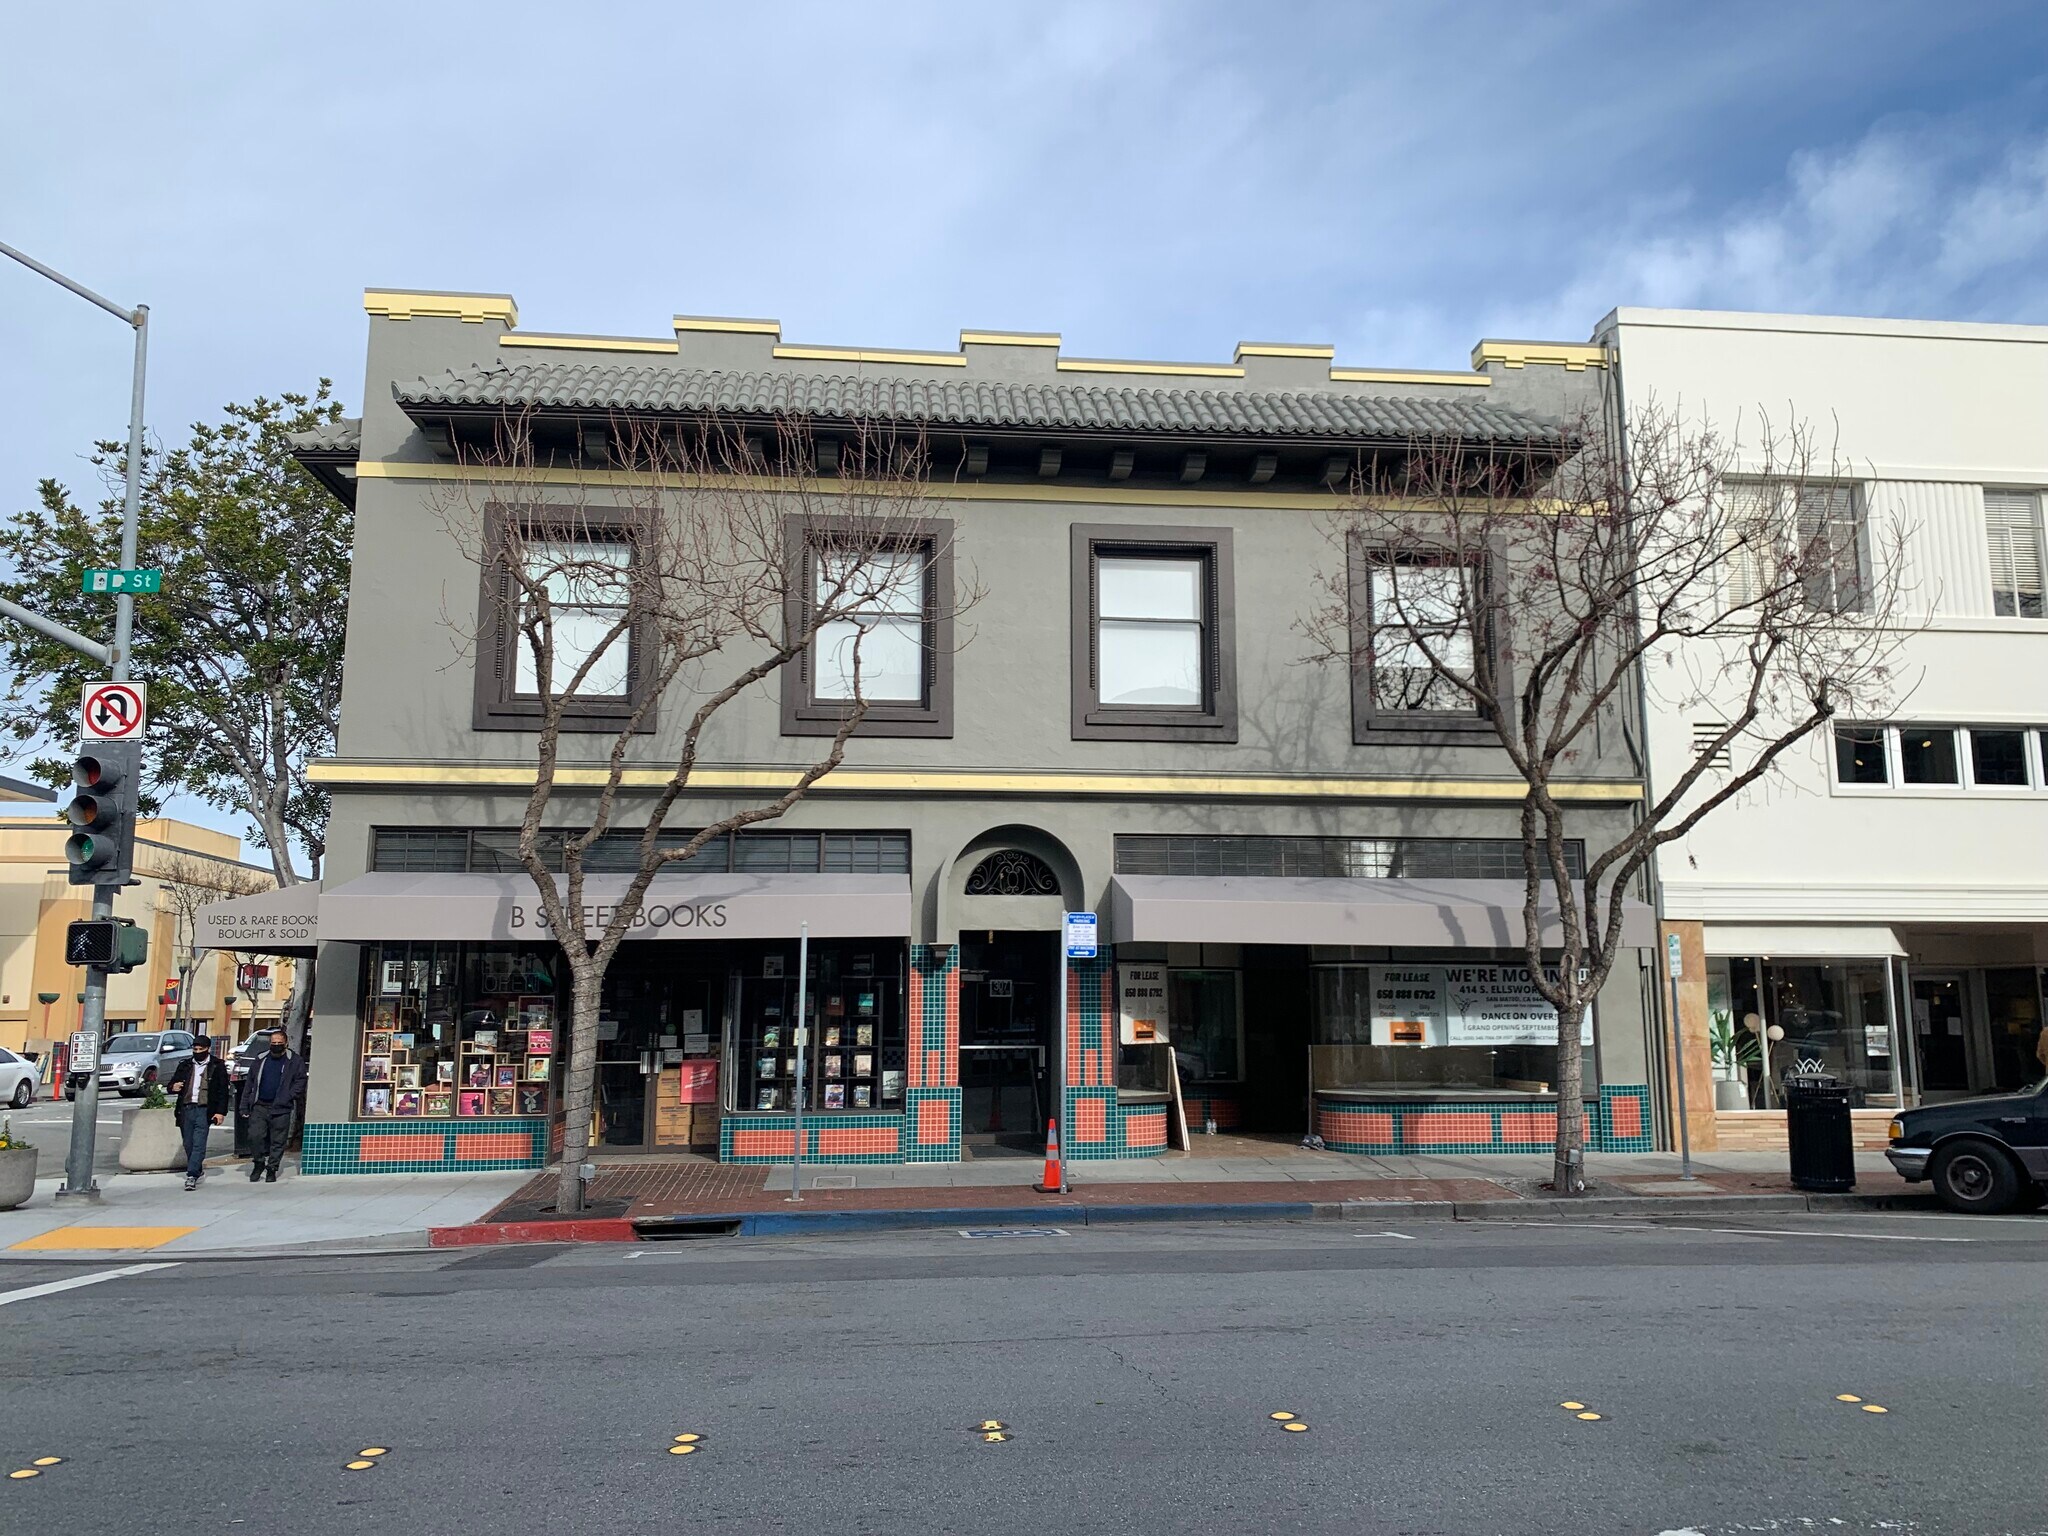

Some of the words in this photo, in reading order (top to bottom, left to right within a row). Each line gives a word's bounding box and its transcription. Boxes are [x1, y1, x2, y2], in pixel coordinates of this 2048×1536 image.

[133, 574, 151, 588] St
[208, 915, 236, 925] USED
[240, 915, 248, 925] &
[251, 915, 278, 925] RARE
[511, 906, 525, 928] B
[535, 905, 622, 928] SEE
[633, 905, 727, 928] BOOKS
[218, 929, 265, 939] BOUGHT
[268, 929, 277, 939] &
[280, 929, 308, 939] SOLD
[1130, 971, 1141, 980] FOR
[1142, 971, 1159, 980] LEASE
[1385, 973, 1401, 982] FOR
[1403, 973, 1430, 982] LEASE
[1445, 969, 1497, 983] WE'RE
[993, 981, 1008, 991] 307
[1459, 985, 1477, 994] 414
[1479, 985, 1489, 994] S.
[1376, 989, 1393, 999] 650
[1481, 1012, 1511, 1020] DANCE
[1512, 1012, 1527, 1020] ON
